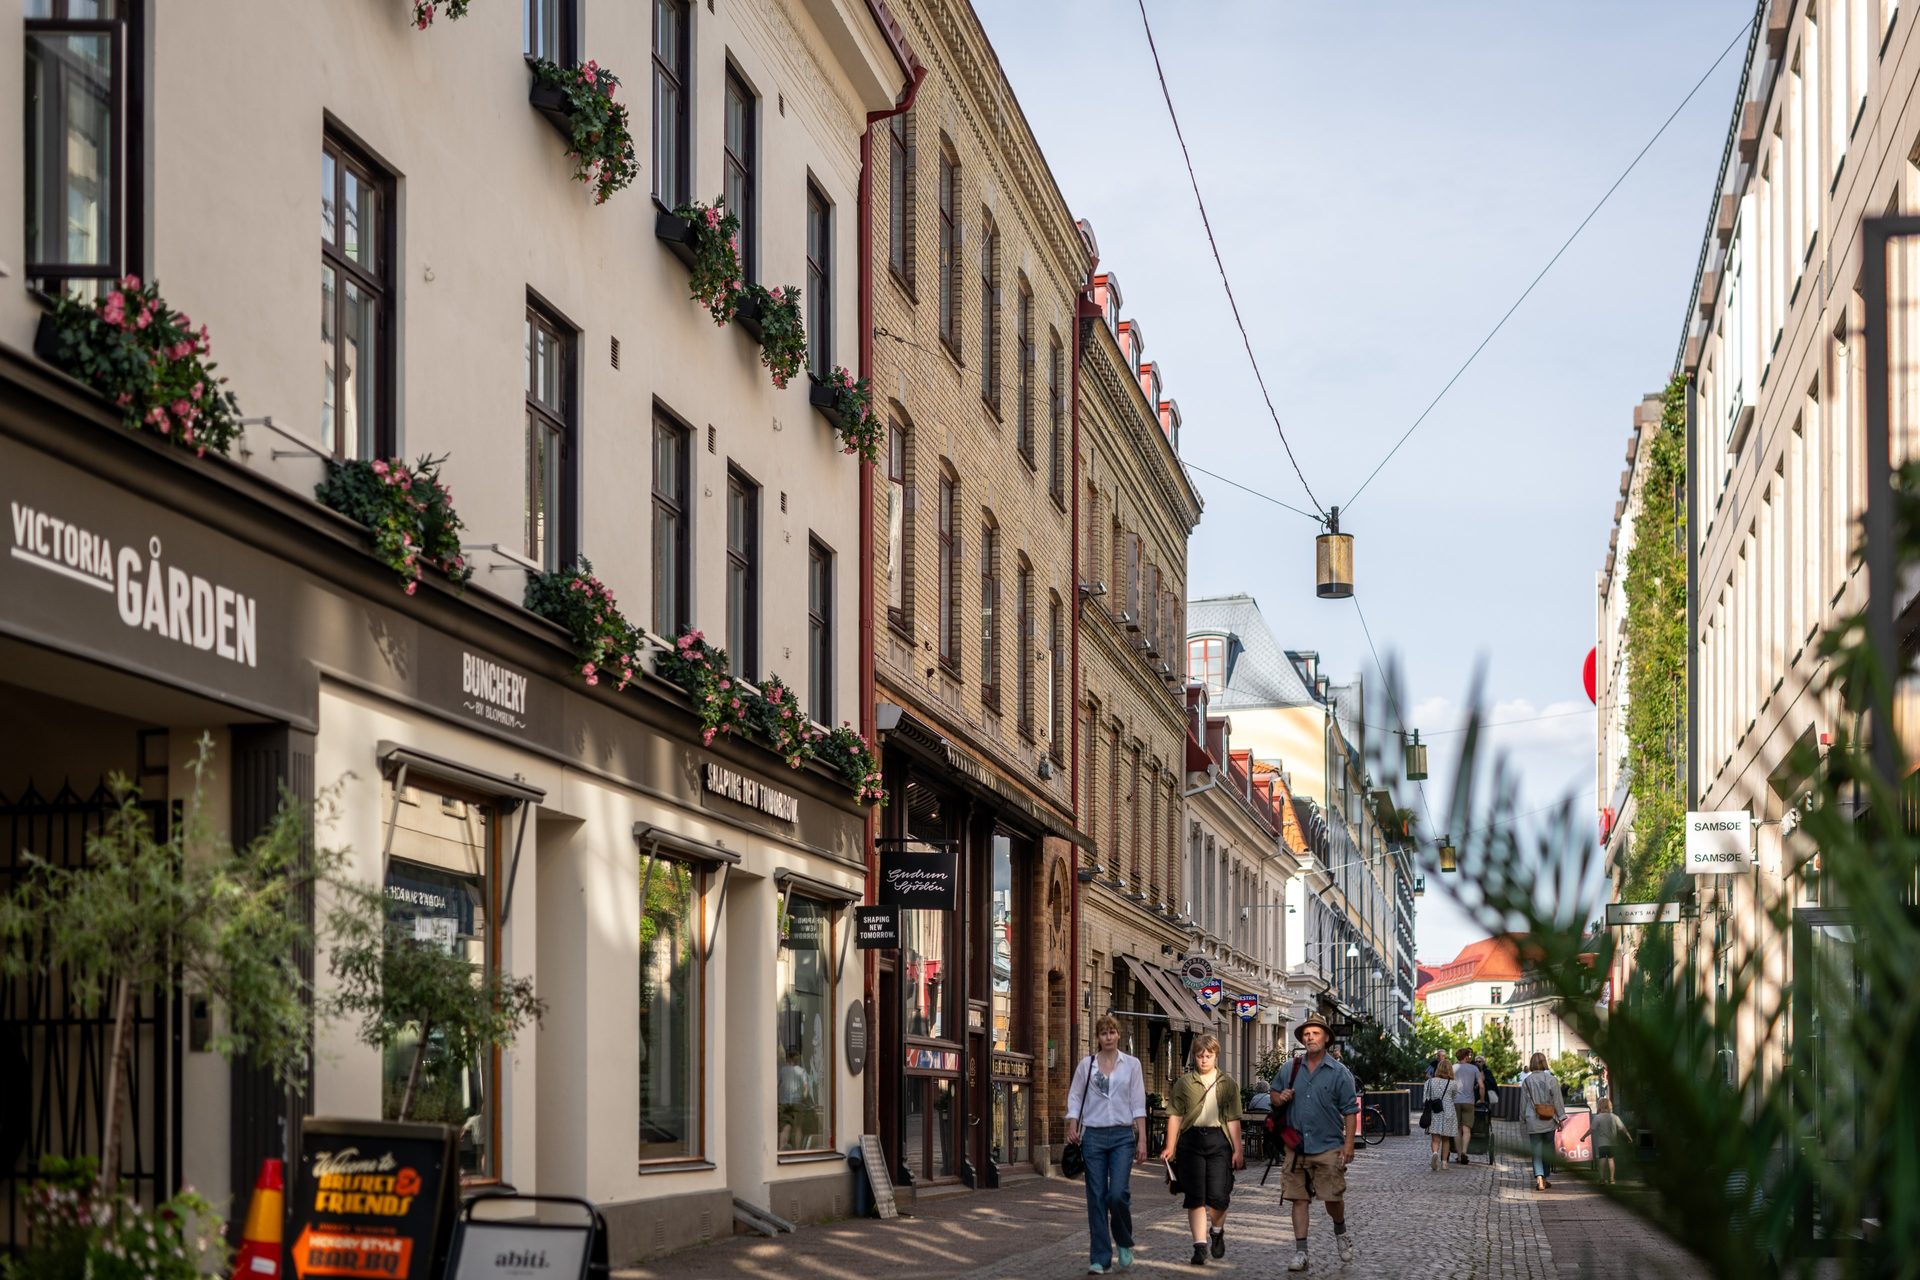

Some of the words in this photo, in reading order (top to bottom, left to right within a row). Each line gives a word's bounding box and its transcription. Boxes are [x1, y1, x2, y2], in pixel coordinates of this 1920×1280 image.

[11, 502, 114, 581] VICTORIA
[117, 535, 256, 668] GÅRDEN
[463, 651, 527, 714] BUNCHERY
[475, 701, 485, 716] BY
[707, 763, 742, 802] SHAPING
[742, 777, 760, 808] NEW
[1694, 821, 1742, 832] SAMSØE
[1694, 853, 1742, 863] SAMSØE
[886, 869, 948, 883] Gudrun
[863, 916, 890, 924] SHAPING
[869, 924, 883, 932] NEW
[1183, 958, 1211, 971] ESPRESSO
[1185, 978, 1208, 988] HOUSE
[1559, 1144, 1590, 1159] Sale
[312, 1147, 379, 1178] Welcome
[378, 1151, 397, 1172] to
[318, 1173, 396, 1193] BRISKET
[314, 1191, 413, 1216] FRIENDS
[360, 1238, 402, 1252] STYLE
